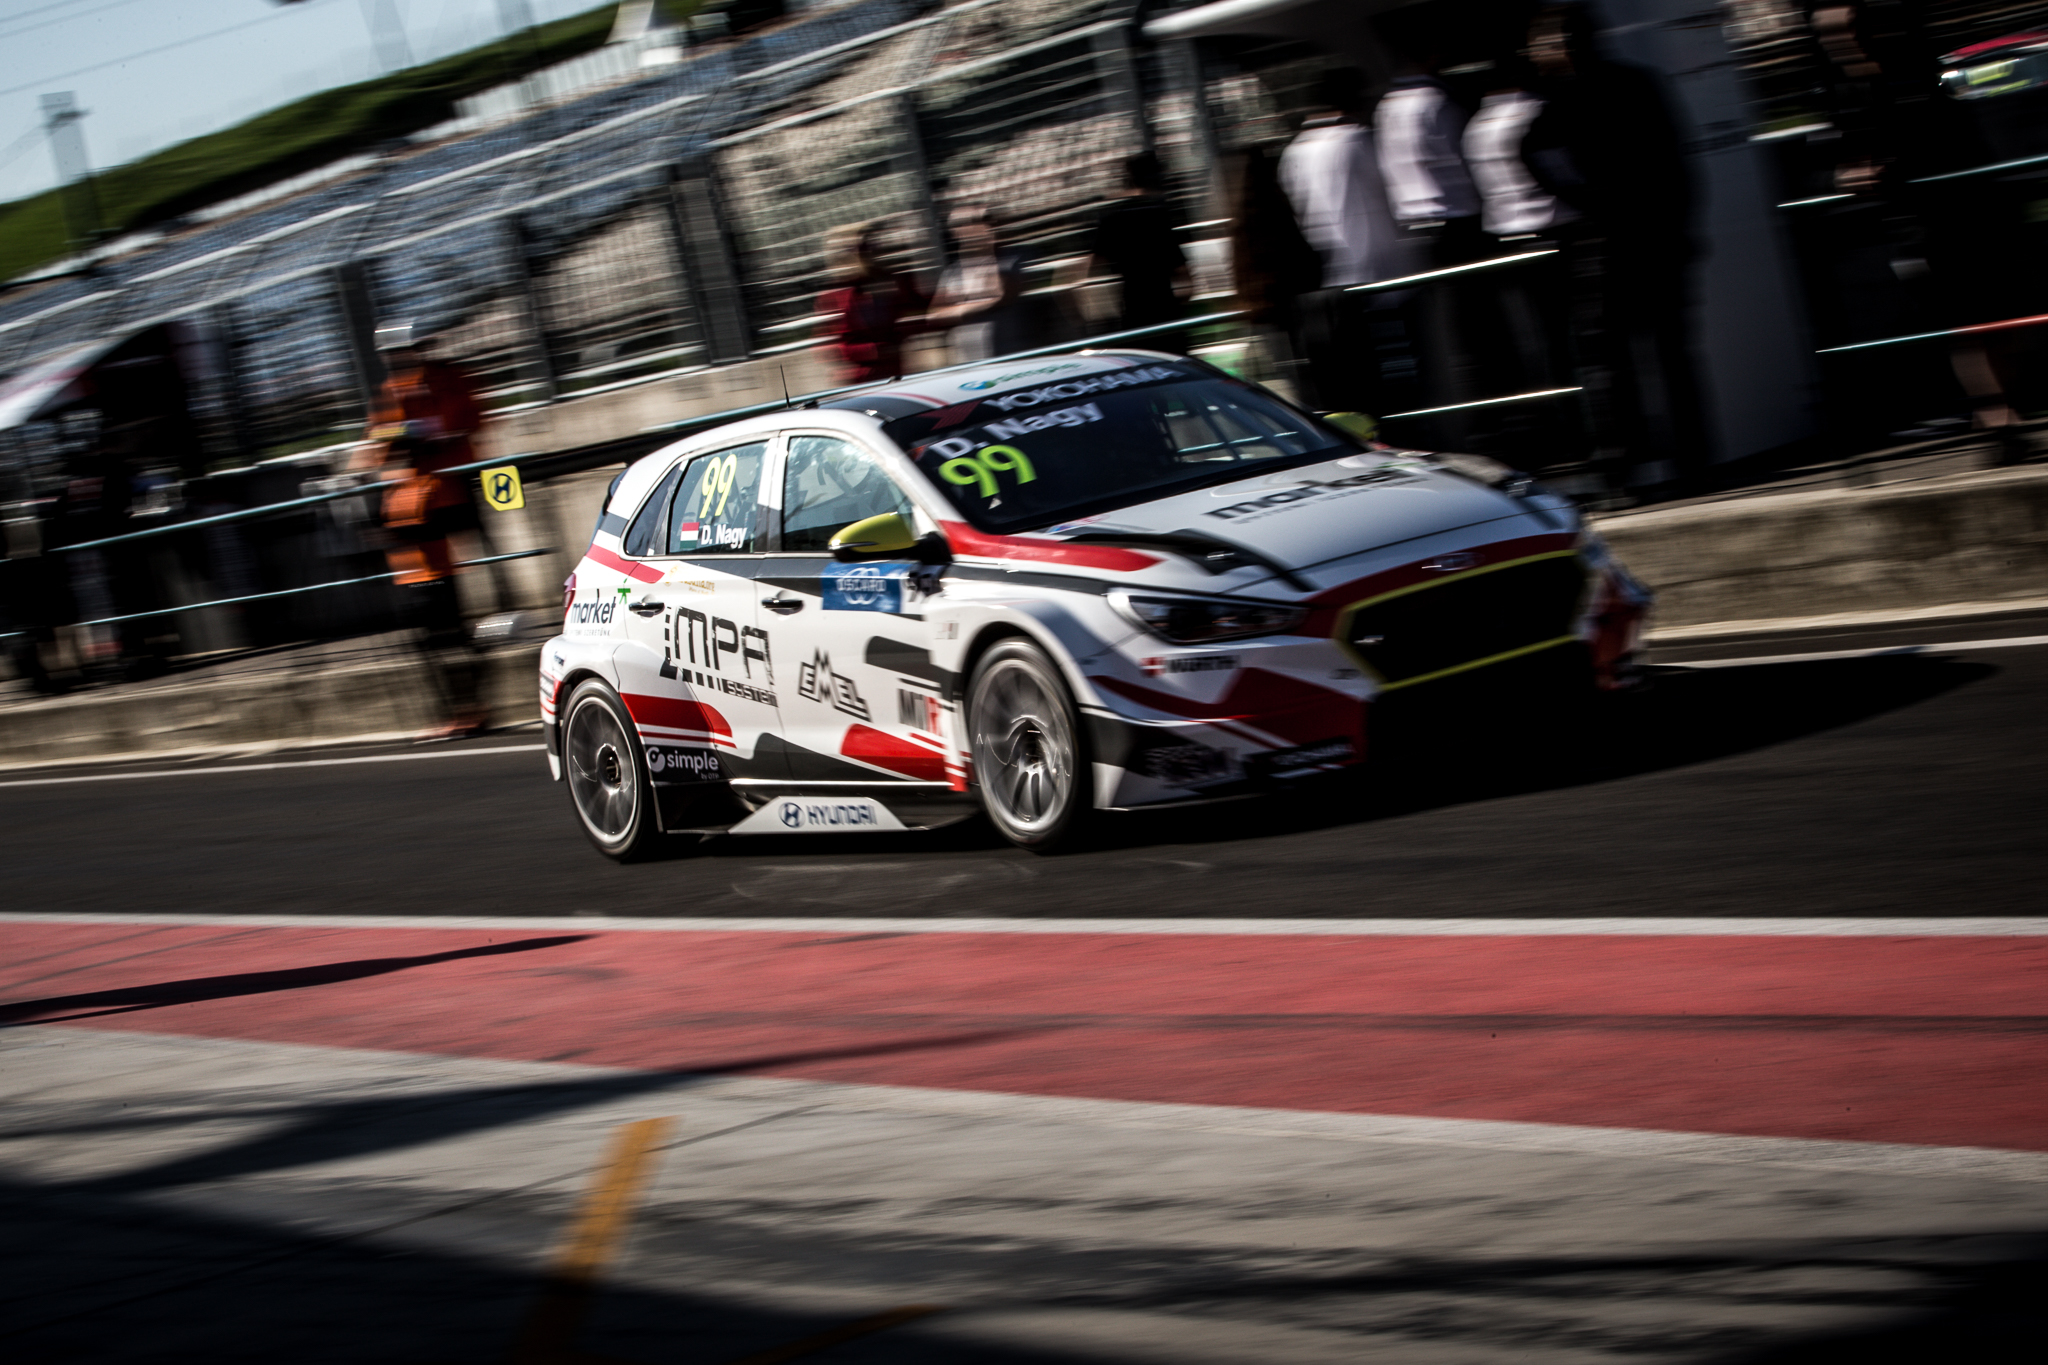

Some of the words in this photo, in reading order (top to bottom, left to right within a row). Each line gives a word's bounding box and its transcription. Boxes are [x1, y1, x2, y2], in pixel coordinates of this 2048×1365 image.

[982, 366, 1187, 412] YOKOHAMA
[928, 436, 990, 460] D.
[983, 402, 1105, 441] Nagy
[699, 453, 737, 519] 99
[938, 444, 1038, 498] 99
[701, 524, 713, 545] D.
[715, 524, 748, 549] Nagy
[570, 588, 616, 624] market
[667, 750, 719, 774] simple
[805, 805, 878, 825] HYUNDAI
